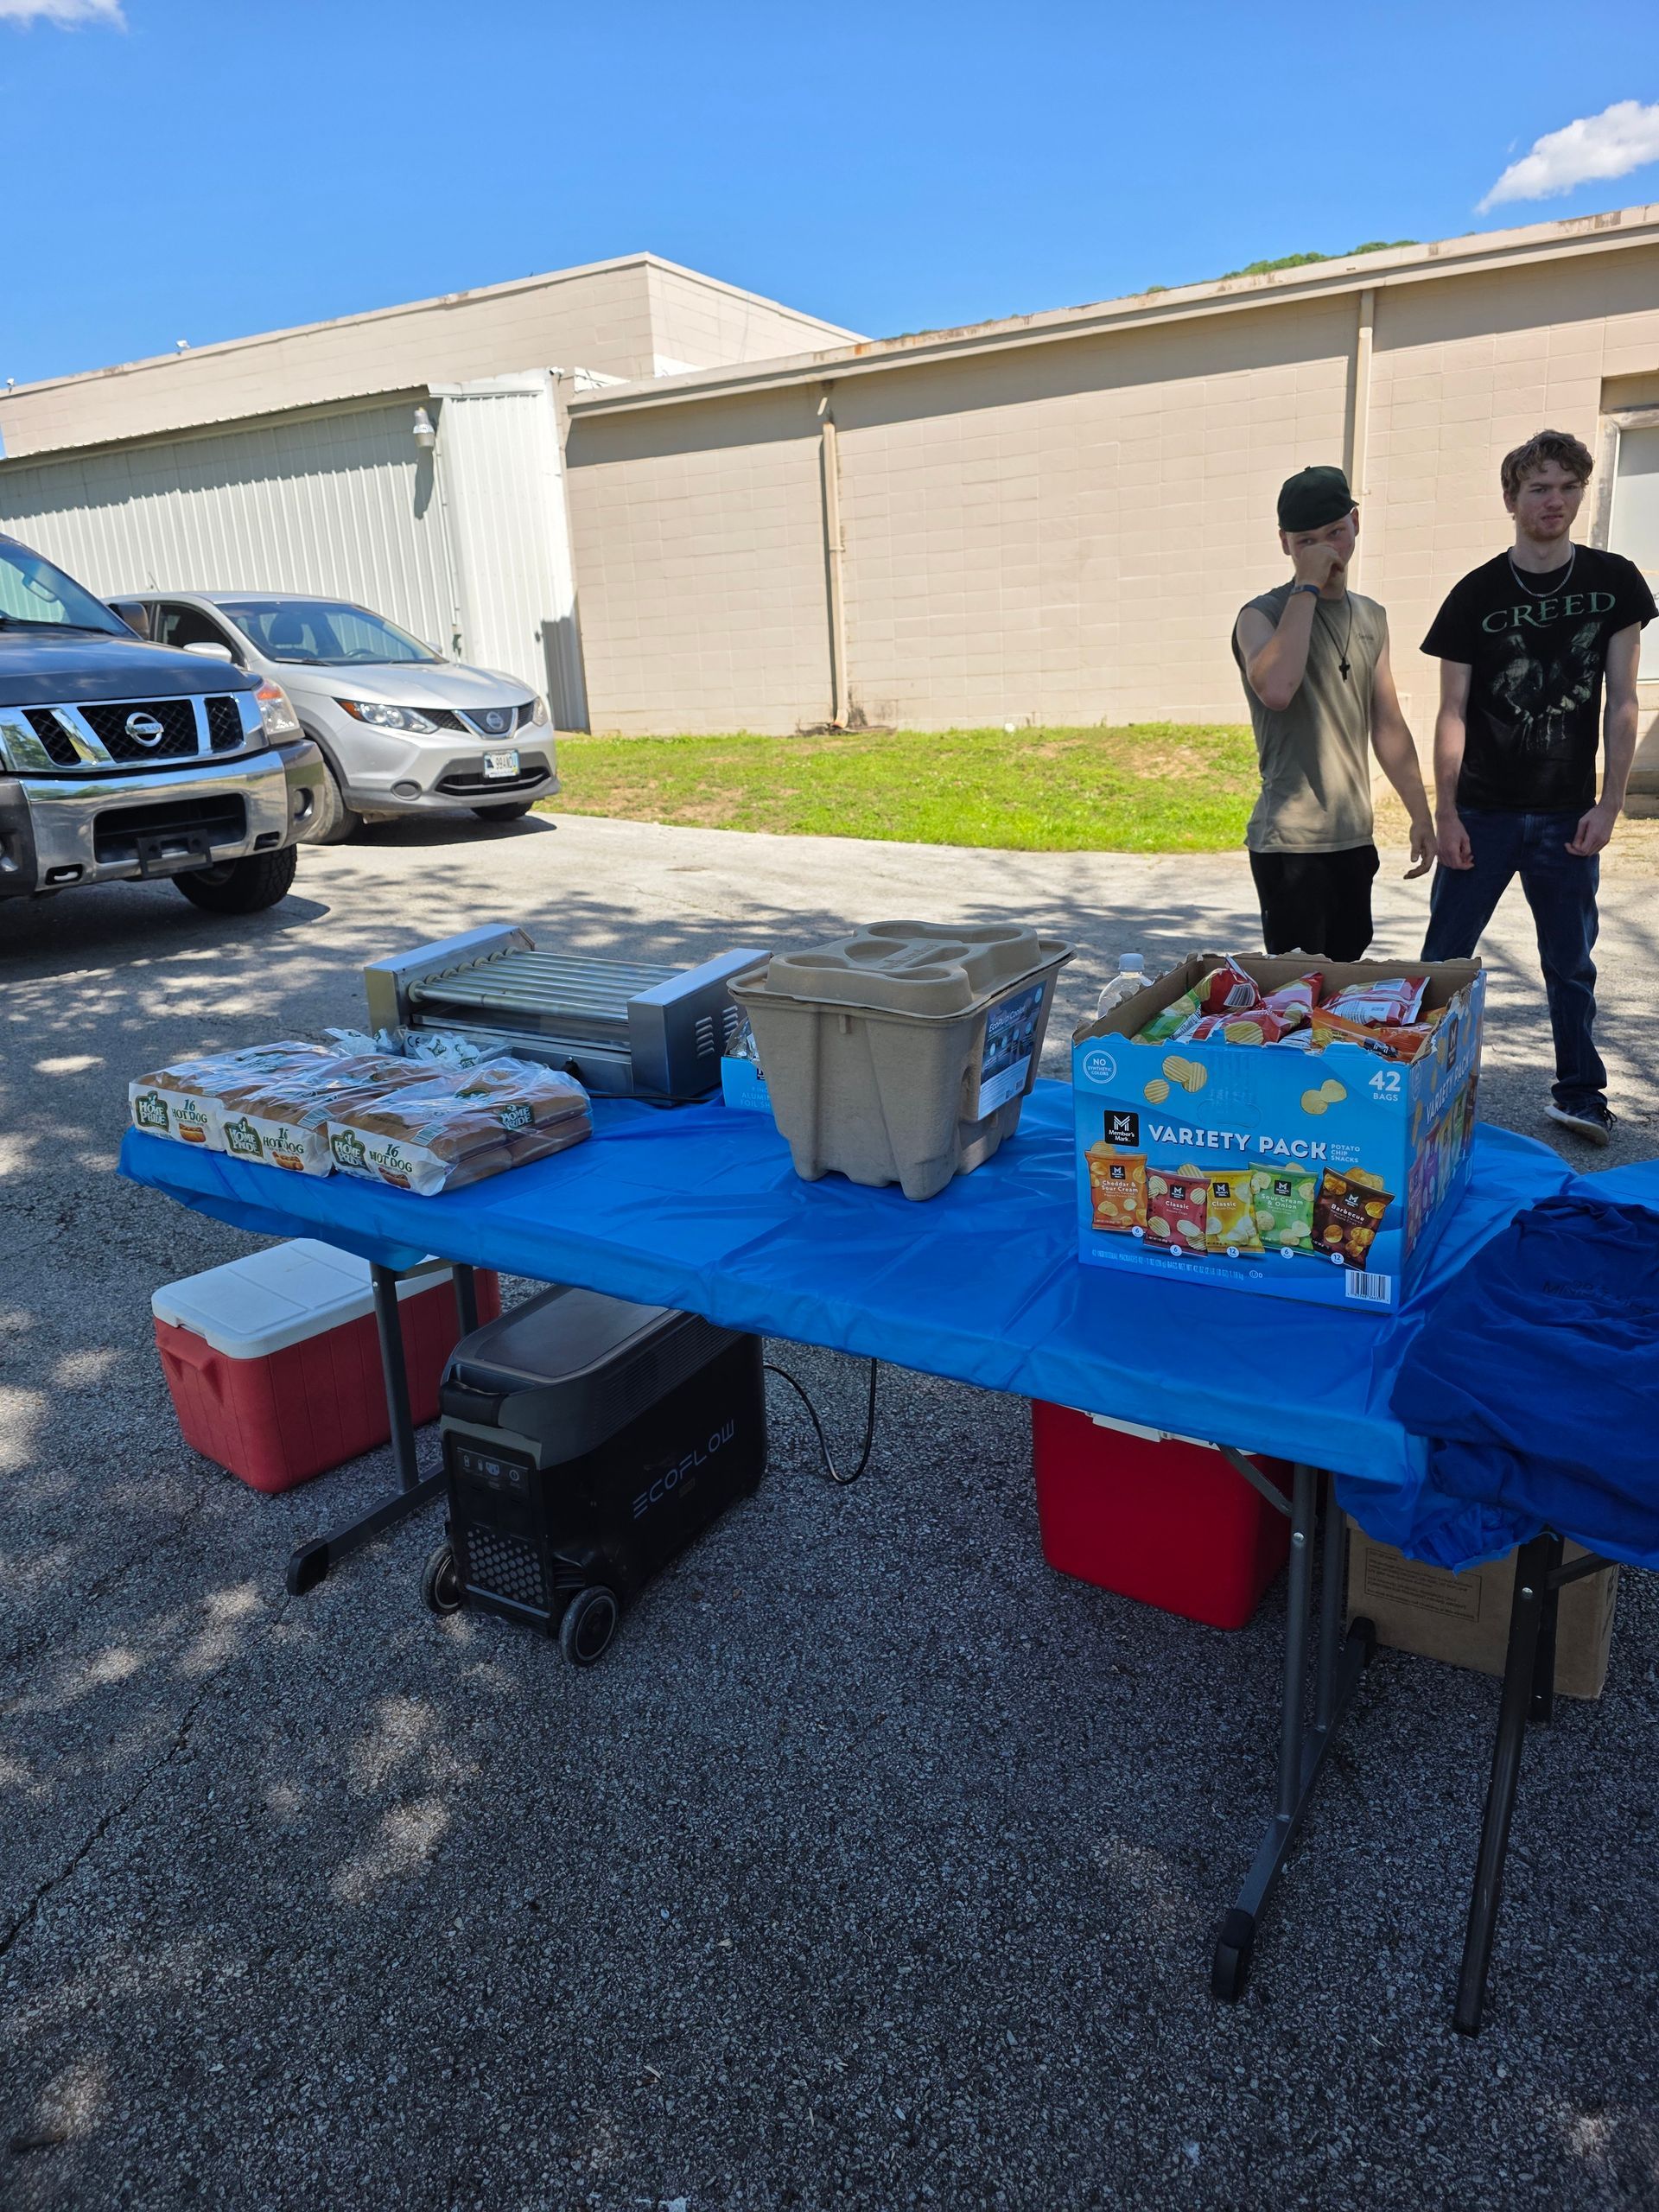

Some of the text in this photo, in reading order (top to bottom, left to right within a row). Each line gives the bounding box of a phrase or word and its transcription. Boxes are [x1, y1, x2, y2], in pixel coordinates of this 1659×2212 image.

[1482, 592, 1616, 633] CREED
[1369, 1070, 1401, 1092] 42
[1373, 1092, 1398, 1102] BAGS
[139, 1101, 164, 1116] HOME
[183, 1099, 195, 1111] 16
[140, 1112, 166, 1125] PRIDE
[171, 1108, 187, 1120] HOT
[188, 1111, 207, 1123] DOG
[501, 1107, 531, 1123] HOME
[505, 1115, 532, 1130] PRIDE
[263, 1136, 283, 1147] HOT
[1148, 1125, 1327, 1160] VARIETY PACK
[334, 1141, 360, 1158] HOME
[385, 1143, 401, 1158] 16
[370, 1151, 387, 1165] HOT
[391, 1159, 412, 1173] DOG
[1165, 1201, 1189, 1210] Classic
[1275, 1201, 1297, 1210] Onion
[1331, 1203, 1365, 1222] Barbecue
[632, 1419, 734, 1519] ECOFLOW
